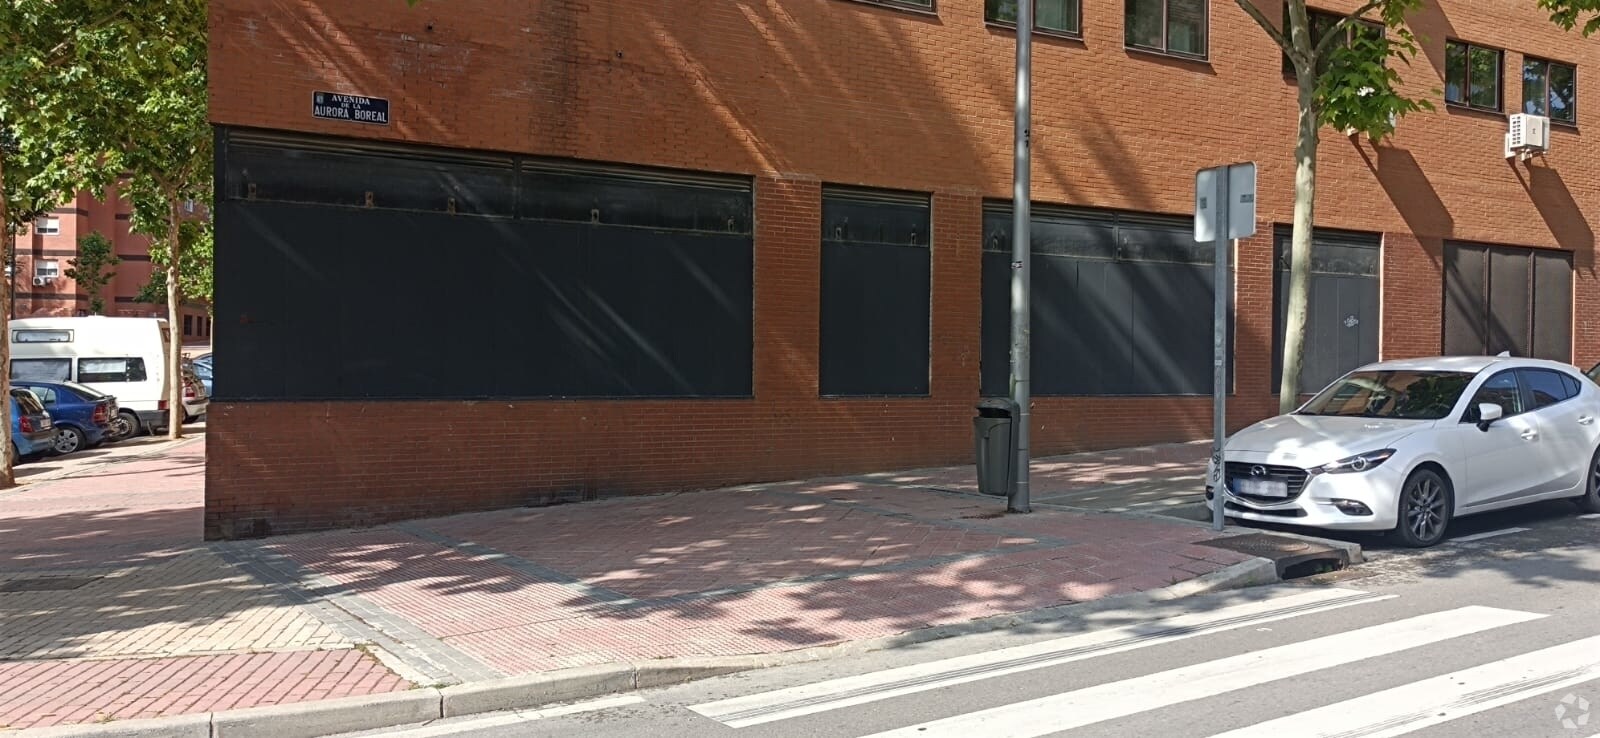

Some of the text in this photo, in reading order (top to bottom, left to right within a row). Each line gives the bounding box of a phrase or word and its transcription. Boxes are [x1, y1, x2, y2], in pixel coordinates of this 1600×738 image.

[331, 95, 370, 105] AVENIDA
[314, 105, 387, 122] AURORA BOREAL
